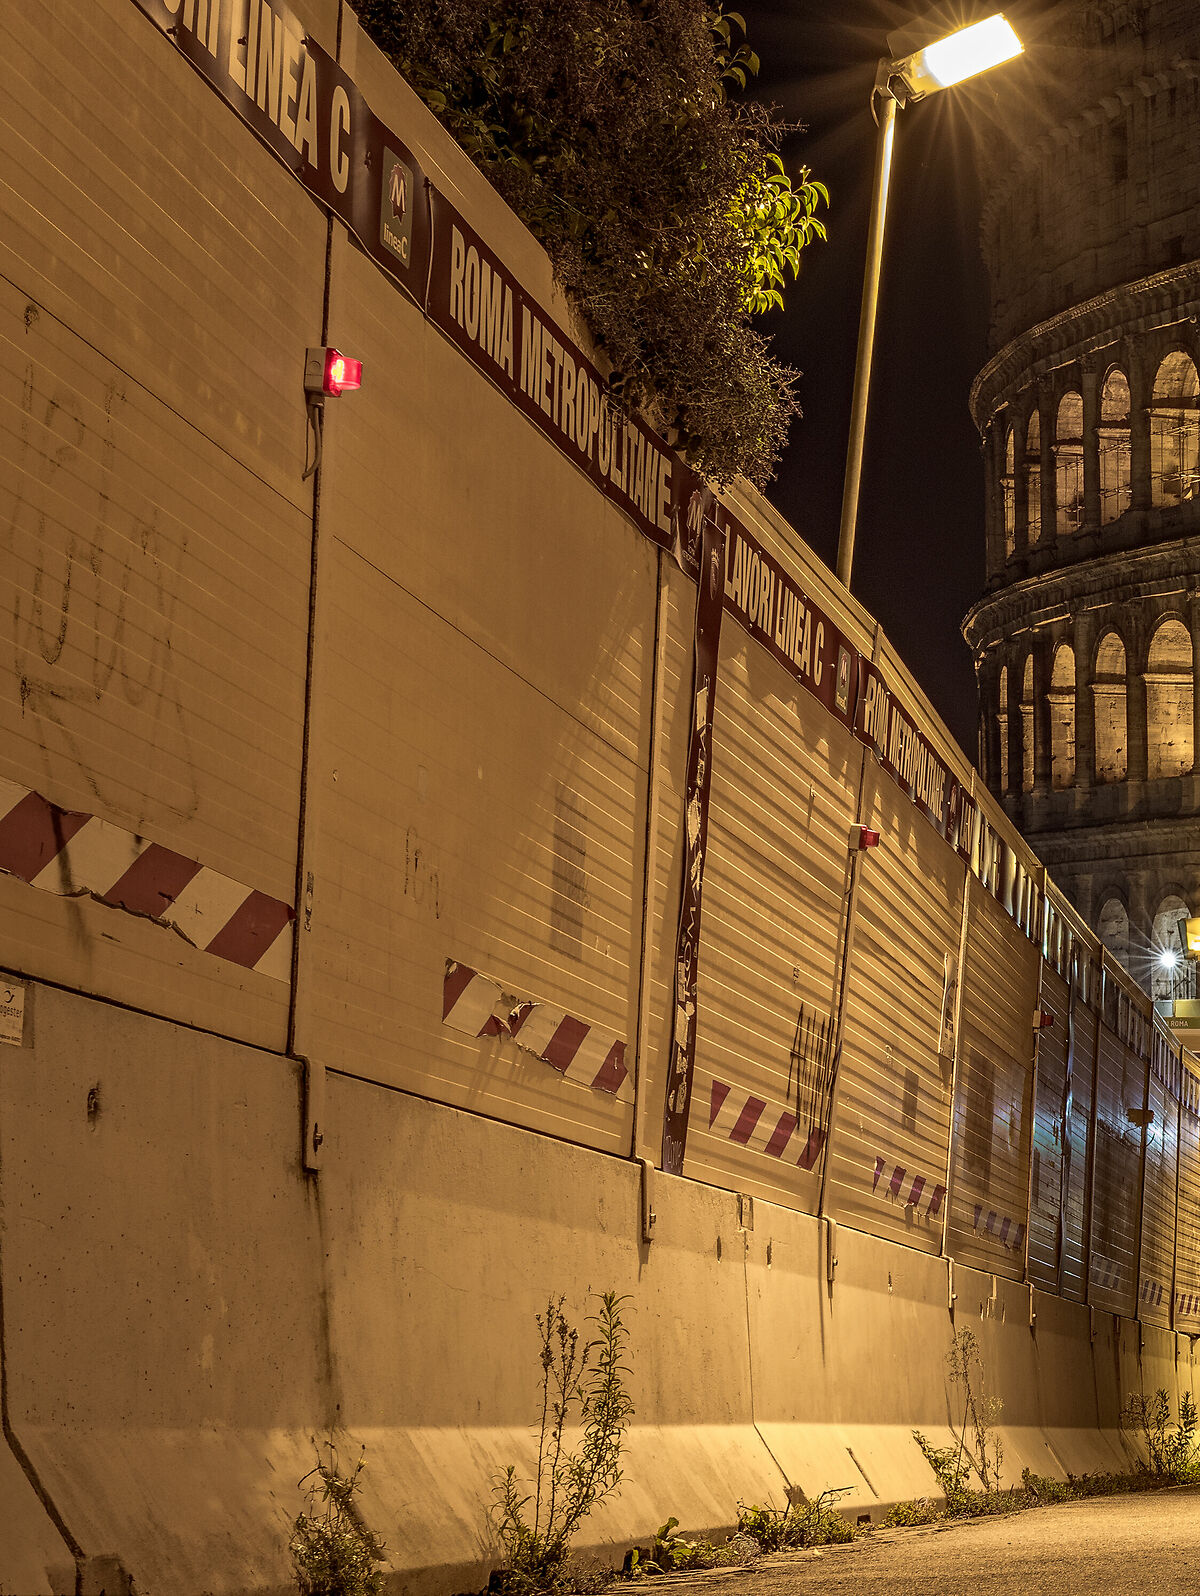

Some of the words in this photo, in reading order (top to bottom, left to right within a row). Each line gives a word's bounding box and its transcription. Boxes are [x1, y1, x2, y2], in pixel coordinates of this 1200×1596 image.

[228, 0, 318, 170] LINEA
[330, 85, 350, 194] C
[383, 222, 408, 260] lineaC
[449, 224, 514, 380] ROMA
[520, 304, 672, 535] METROPOLITANE
[724, 523, 775, 637] LAVORI
[775, 579, 812, 677] LINEA
[813, 621, 825, 687] C
[863, 673, 889, 758] ROMA
[888, 705, 946, 823] METROPOLITANE
[1170, 1020, 1189, 1028] ROMA
